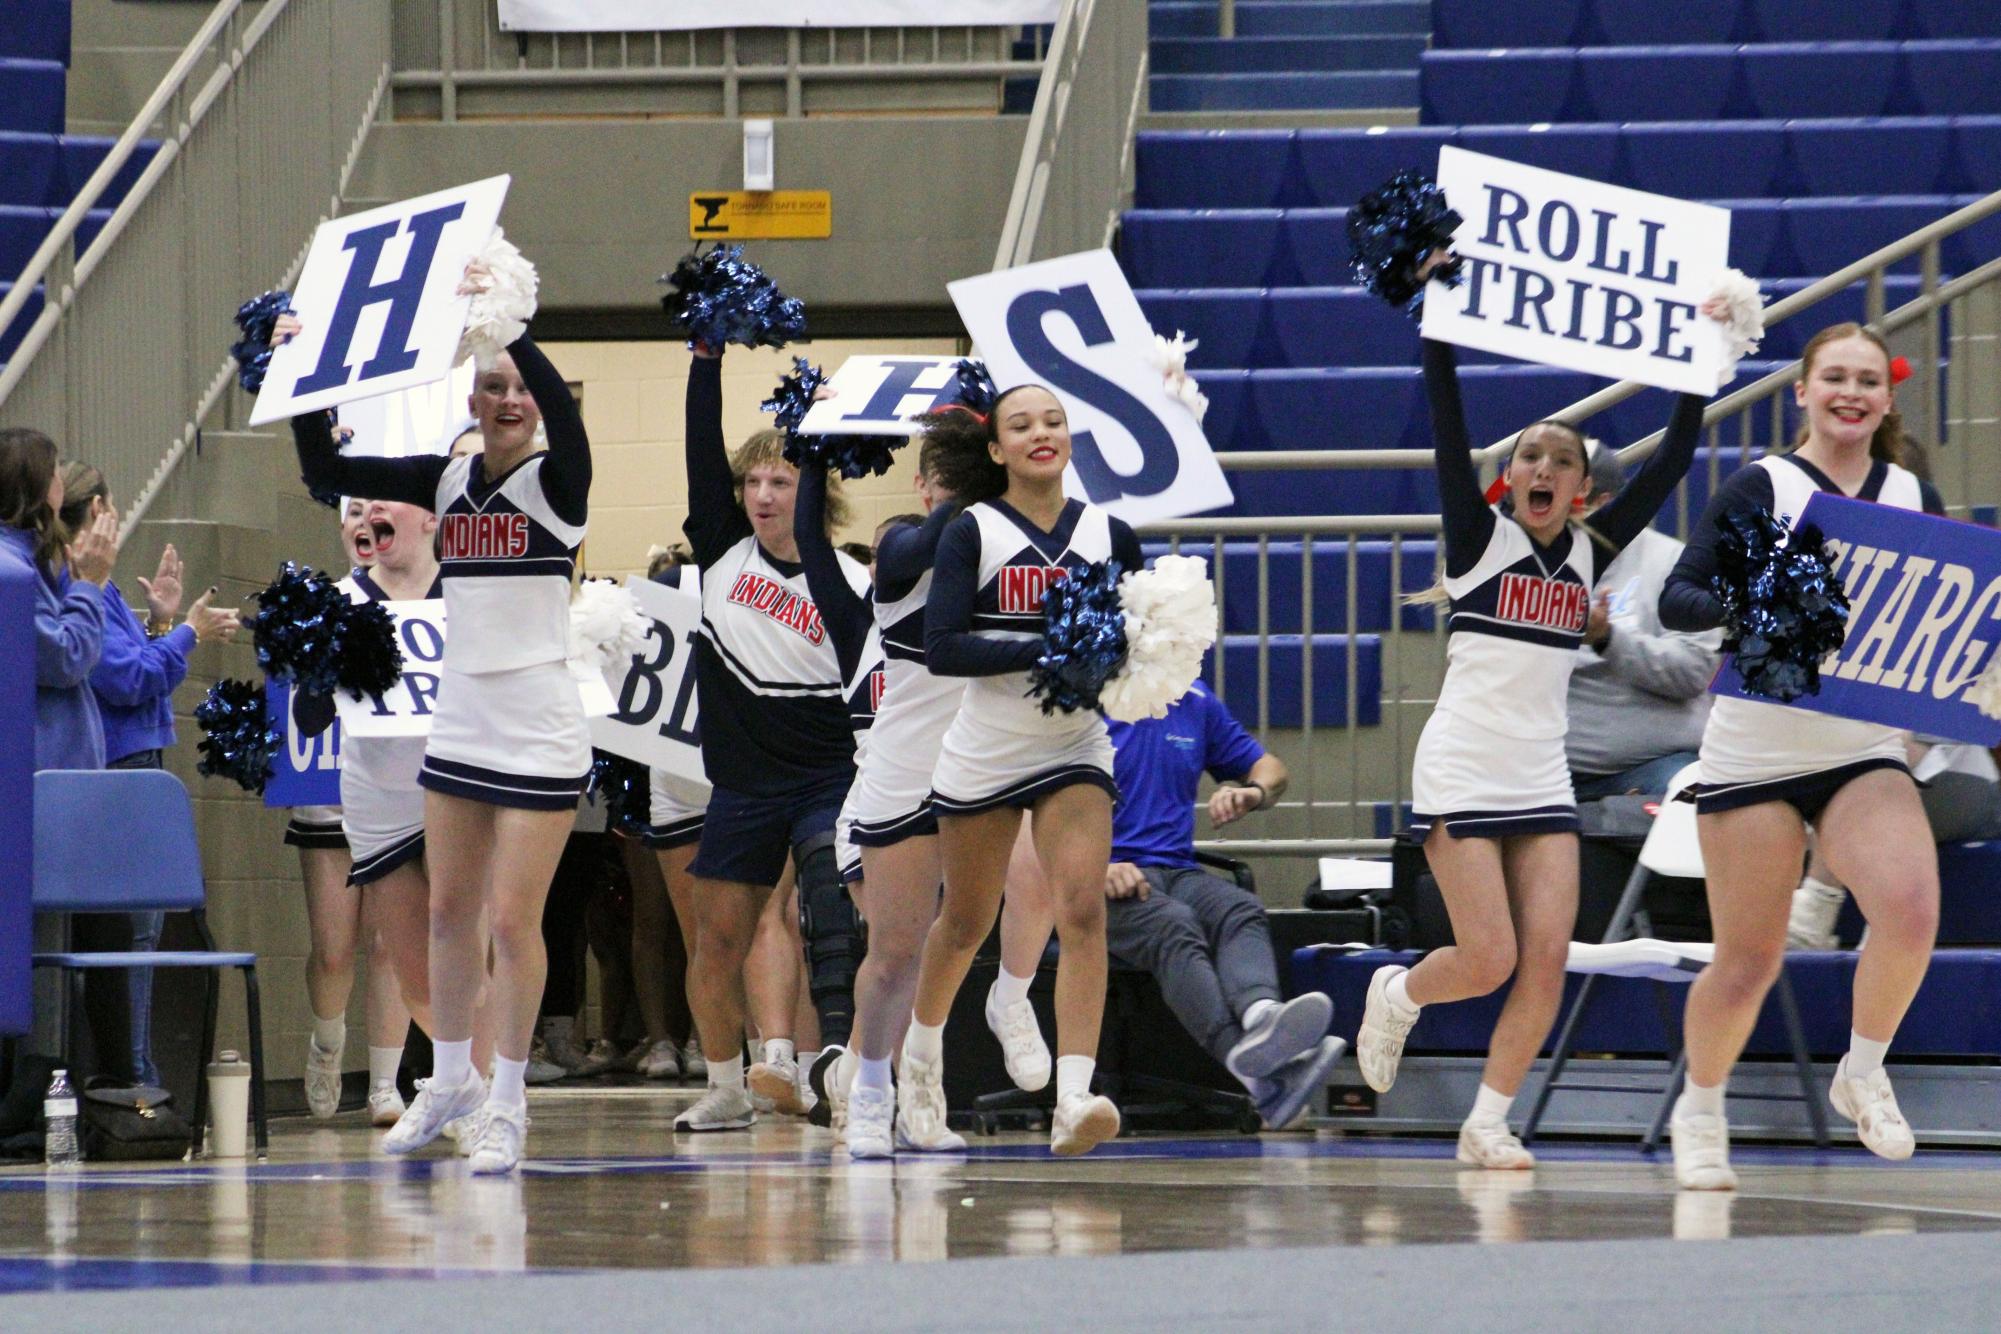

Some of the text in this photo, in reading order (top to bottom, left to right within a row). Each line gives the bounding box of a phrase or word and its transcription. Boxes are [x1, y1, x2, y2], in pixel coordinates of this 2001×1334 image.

[1477, 183, 1679, 285] ROLL
[291, 201, 466, 398] H
[1460, 256, 1697, 363] TRIBE
[1006, 283, 1180, 504] S
[727, 571, 826, 647] INDIANS
[1497, 572, 1589, 632] INDIANS
[1818, 538, 2001, 705] HARG
